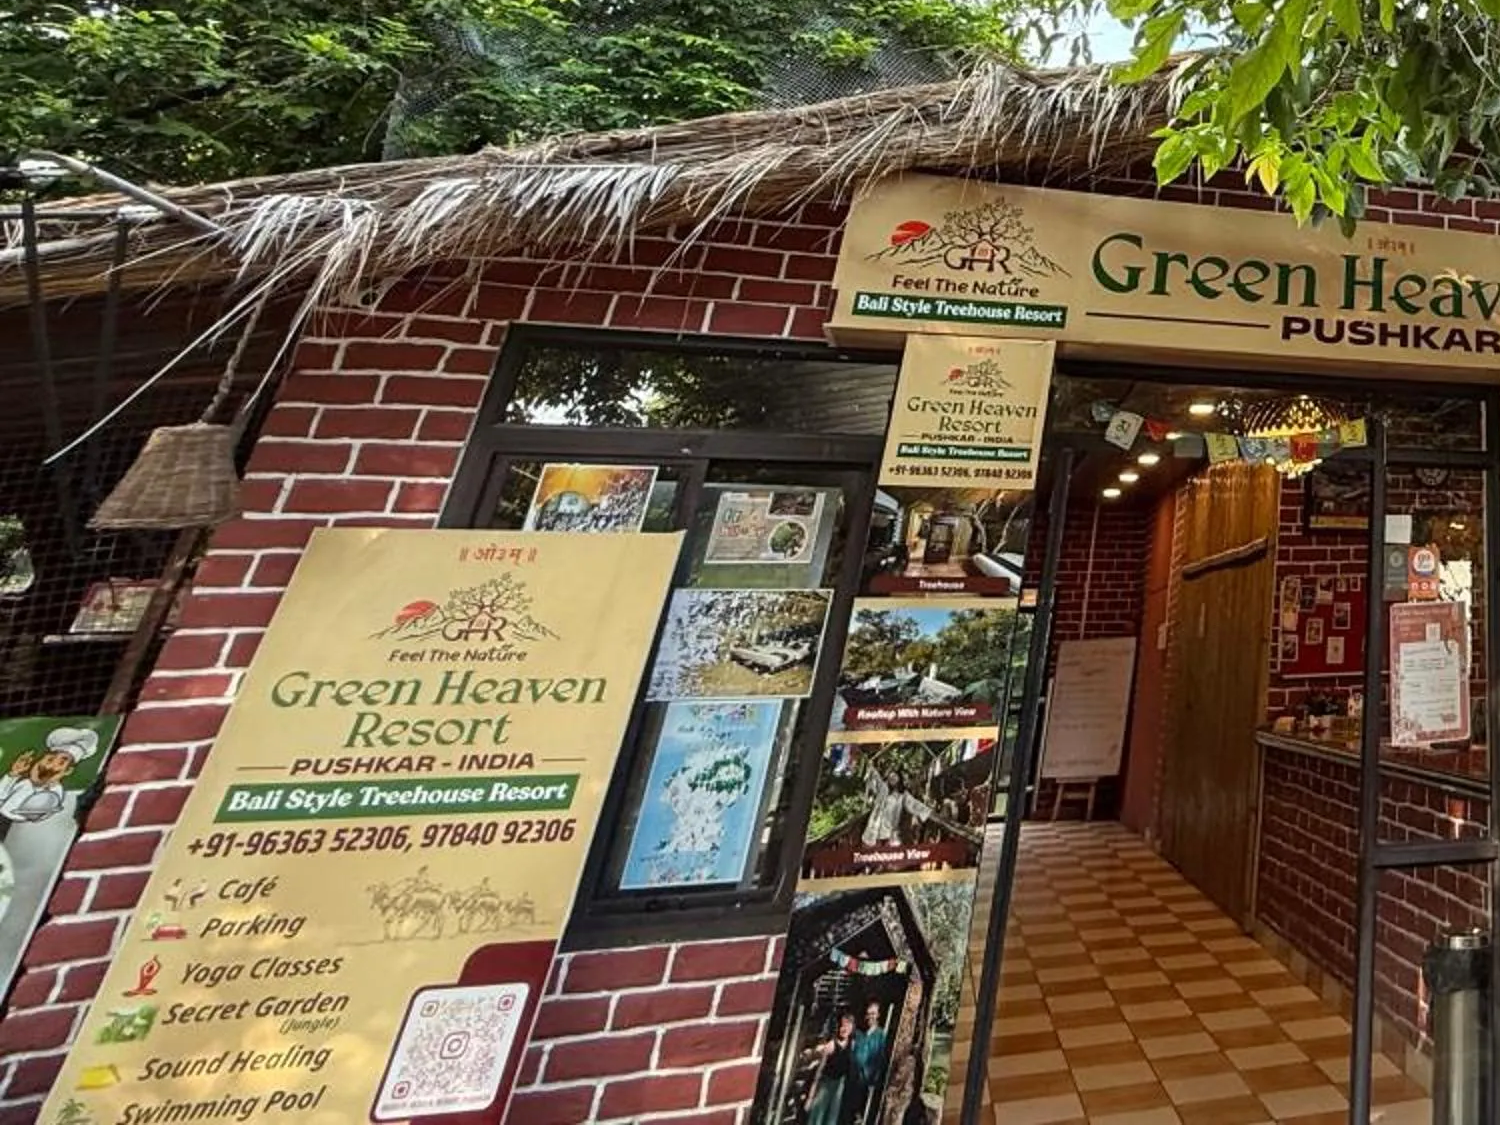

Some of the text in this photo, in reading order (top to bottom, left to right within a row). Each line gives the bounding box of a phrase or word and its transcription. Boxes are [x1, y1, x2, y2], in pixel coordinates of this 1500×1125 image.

[1091, 232, 1319, 308] Green
[892, 274, 1041, 299] Feel The Nature
[857, 295, 1064, 324] Bali Style Treehouse Resort
[907, 396, 1037, 418] Green Heaven
[939, 416, 1002, 434] Resort
[919, 580, 964, 591] Treehouse
[388, 644, 527, 662] Feel The Nature
[271, 671, 607, 708] Green Heaven
[955, 706, 976, 717] View
[344, 711, 513, 749] Resort
[289, 753, 535, 776] PUSHKAR INDIA
[228, 781, 569, 814] Bali Style Treehouse Resort
[187, 818, 577, 859] +91-96363 52306, 97840 92306
[853, 849, 931, 863] Treehouse View
[218, 875, 277, 901] Café
[200, 912, 307, 939] Parking
[179, 953, 345, 988] Yoga Classes
[161, 992, 350, 1027] Secret Garden
[137, 1045, 332, 1082] Sound Healing
[115, 1084, 328, 1125] Swimming Pool
